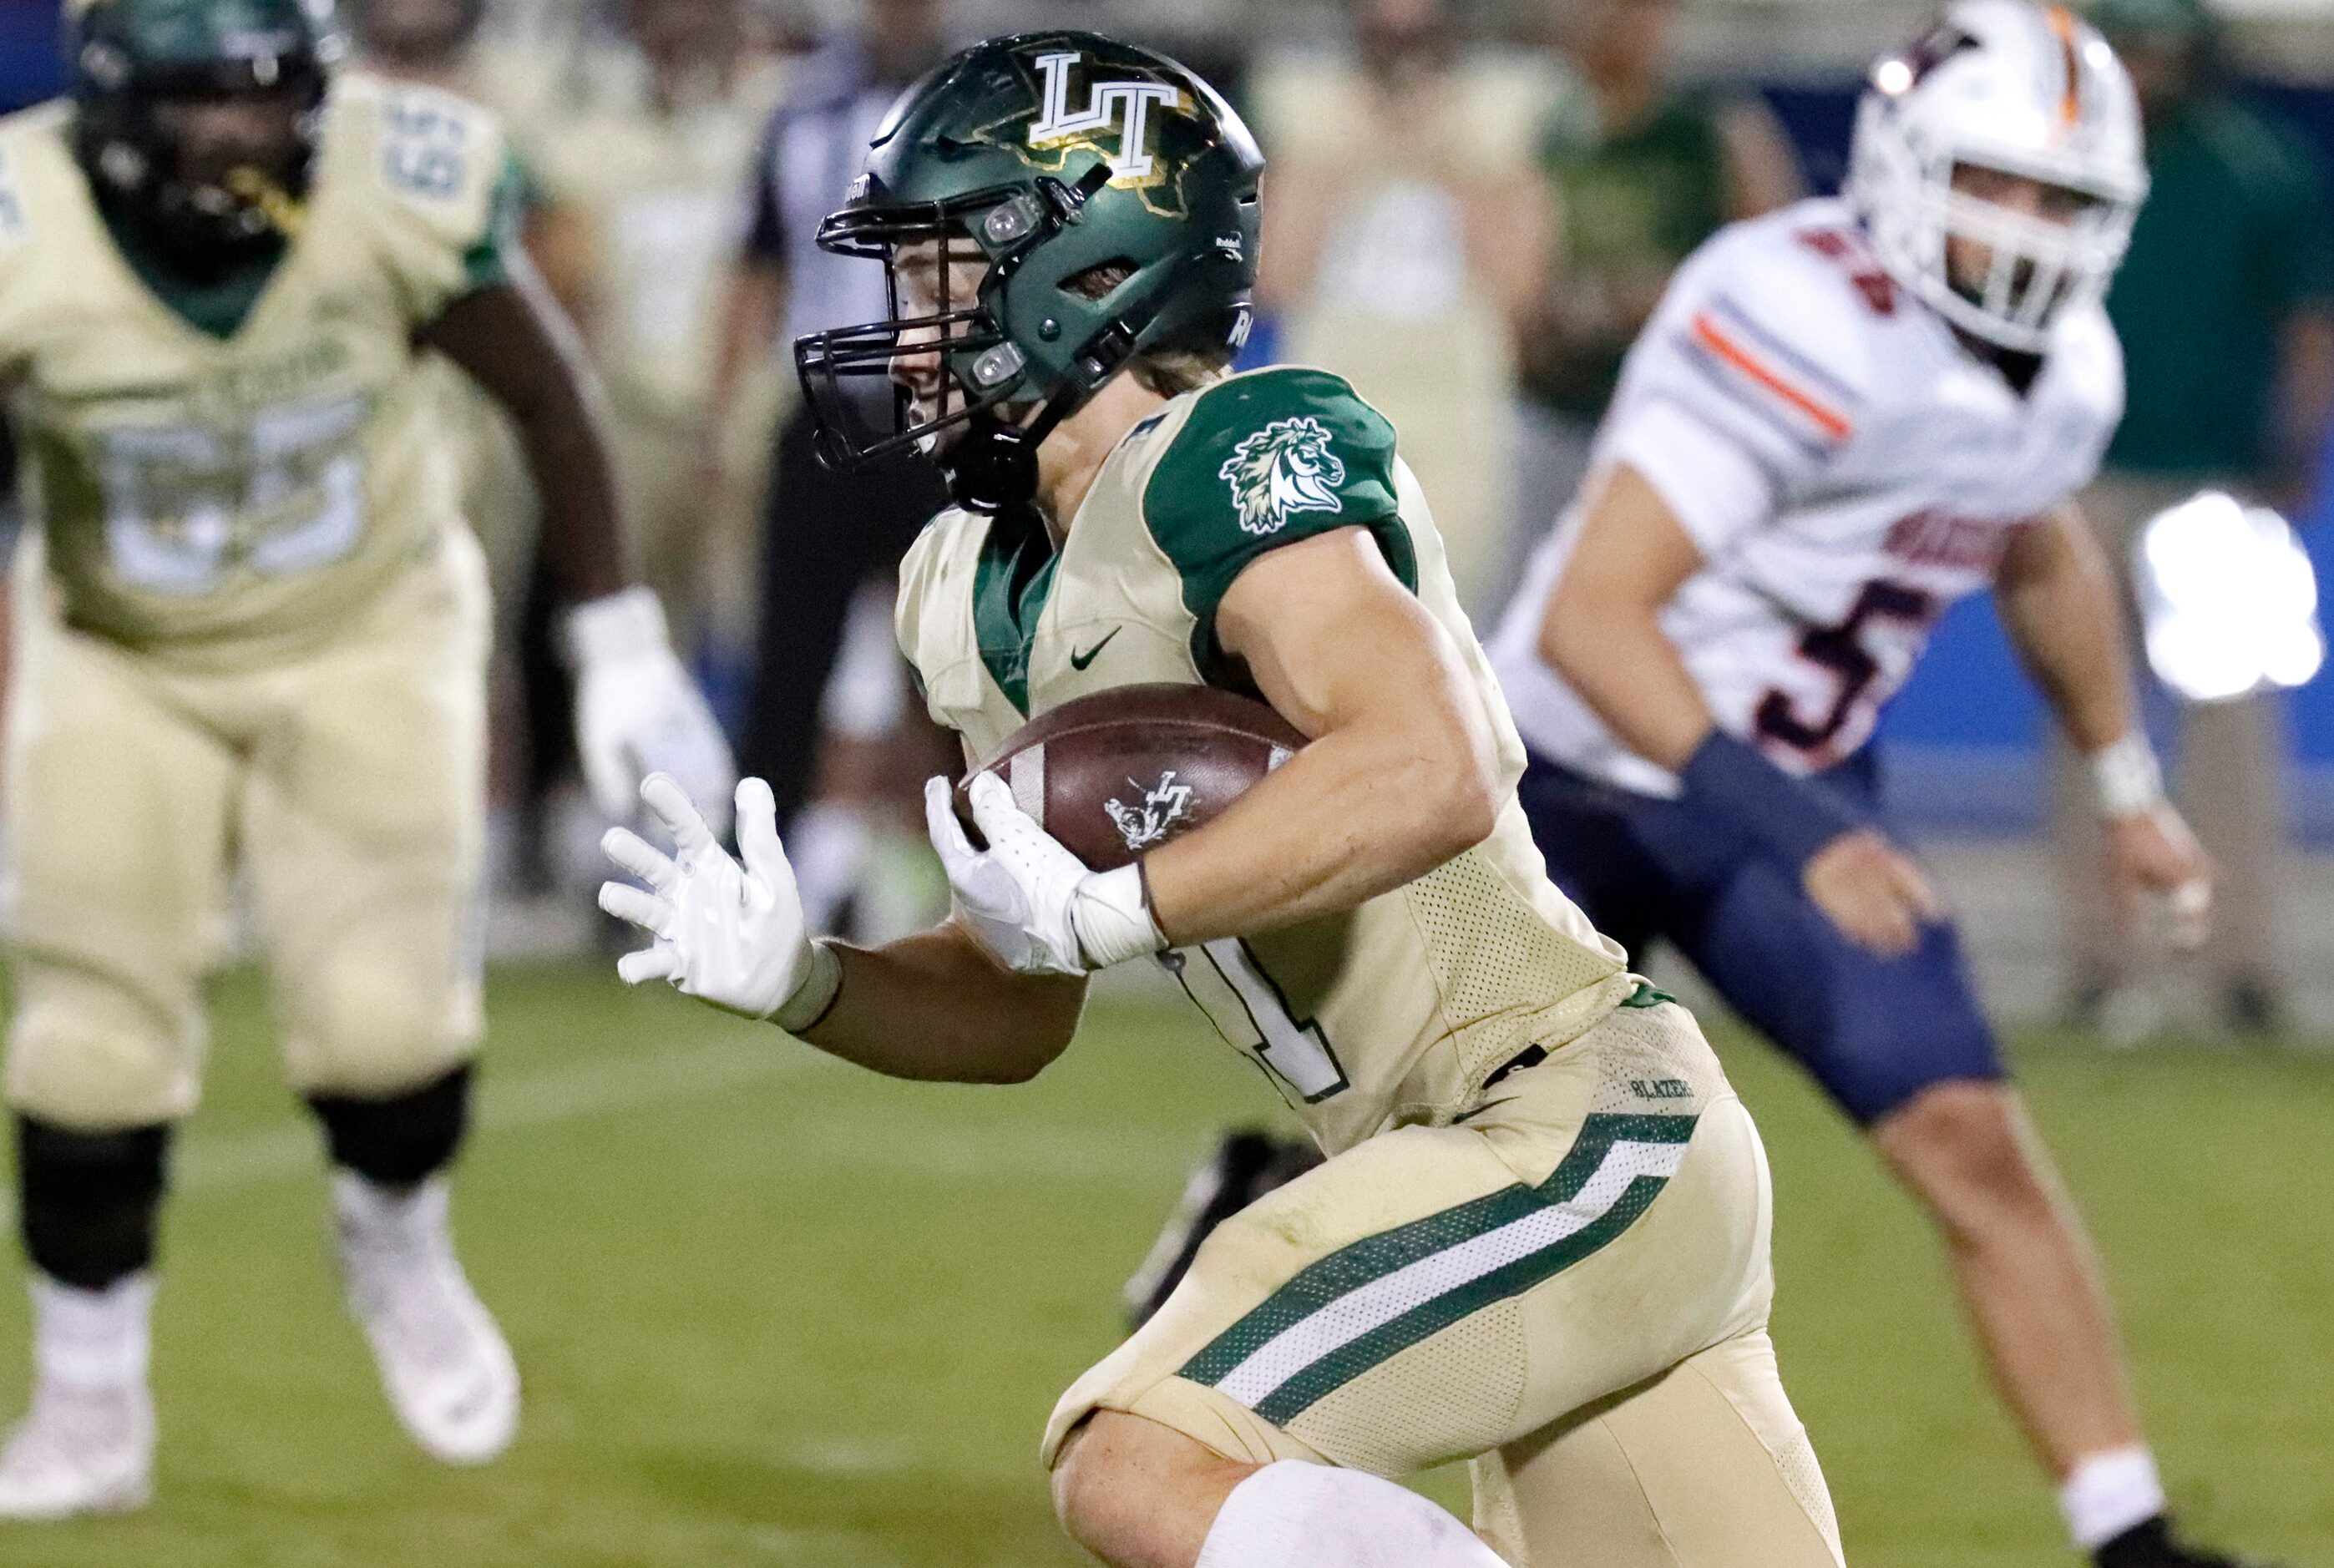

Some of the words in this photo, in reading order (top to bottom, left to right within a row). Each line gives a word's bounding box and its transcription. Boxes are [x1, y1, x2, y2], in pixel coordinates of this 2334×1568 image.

[1029, 53, 1178, 180] LT
[1216, 236, 1241, 248] Riddell
[1752, 576, 1937, 756] 5
[1146, 771, 1192, 816] LT
